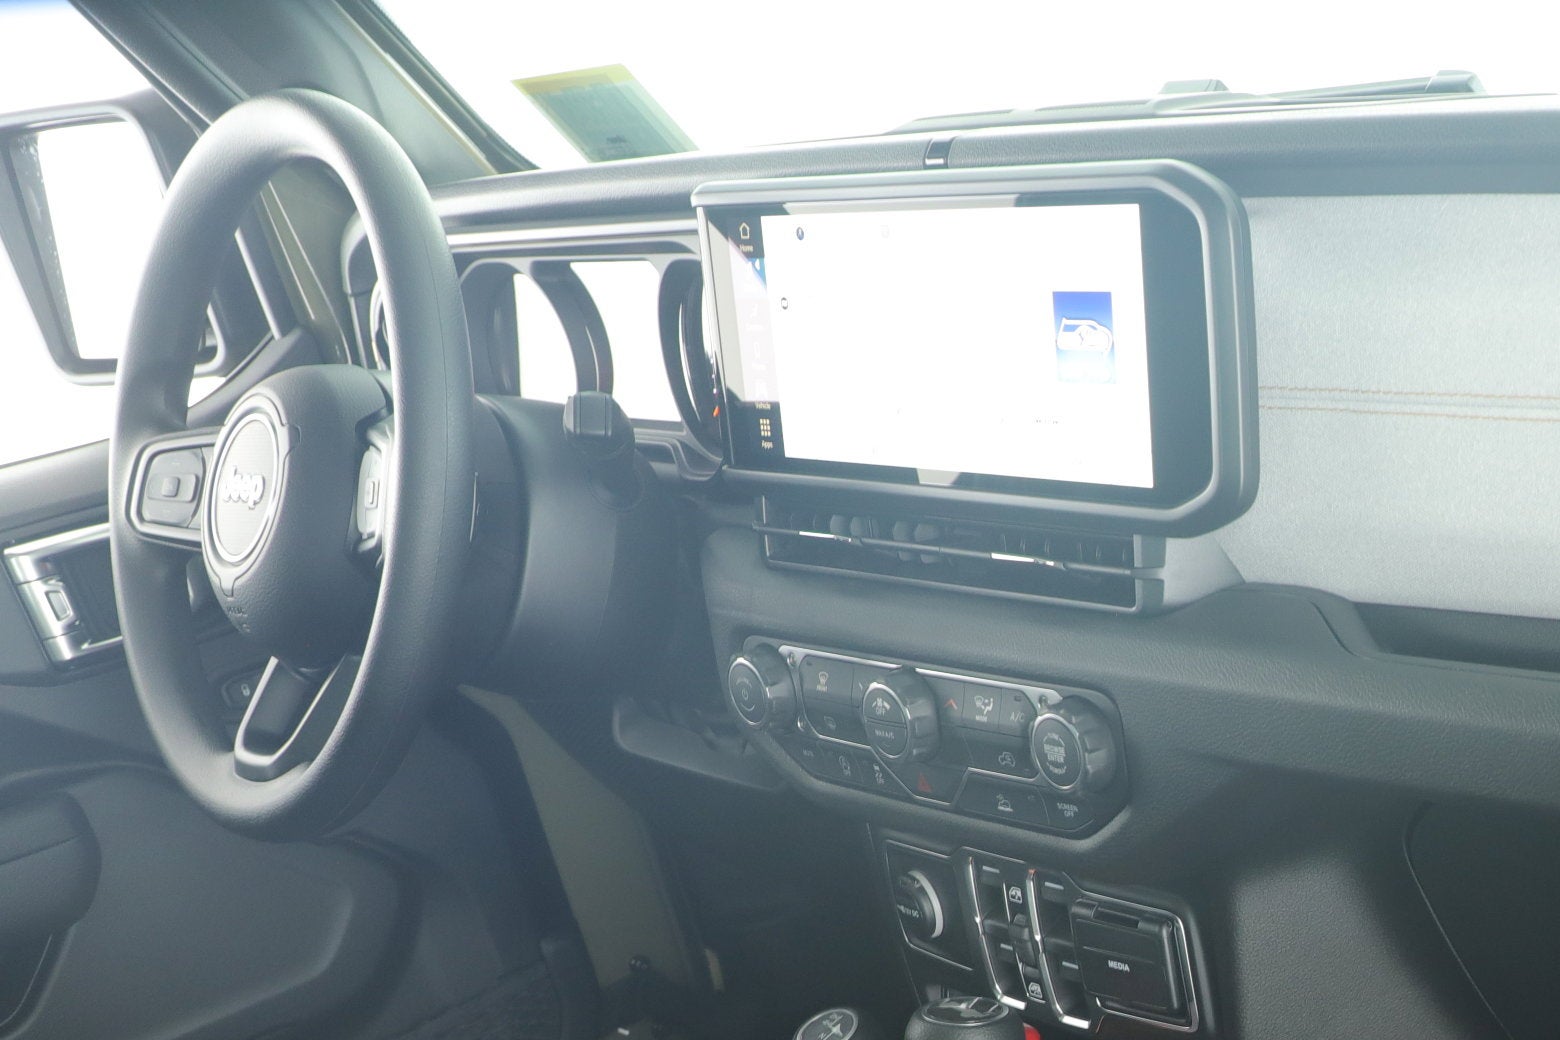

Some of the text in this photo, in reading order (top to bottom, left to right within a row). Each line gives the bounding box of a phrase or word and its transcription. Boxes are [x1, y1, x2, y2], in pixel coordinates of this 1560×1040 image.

[761, 440, 773, 450] Apps
[1010, 711, 1025, 721] A/C
[1107, 959, 1130, 972] MEDIA
